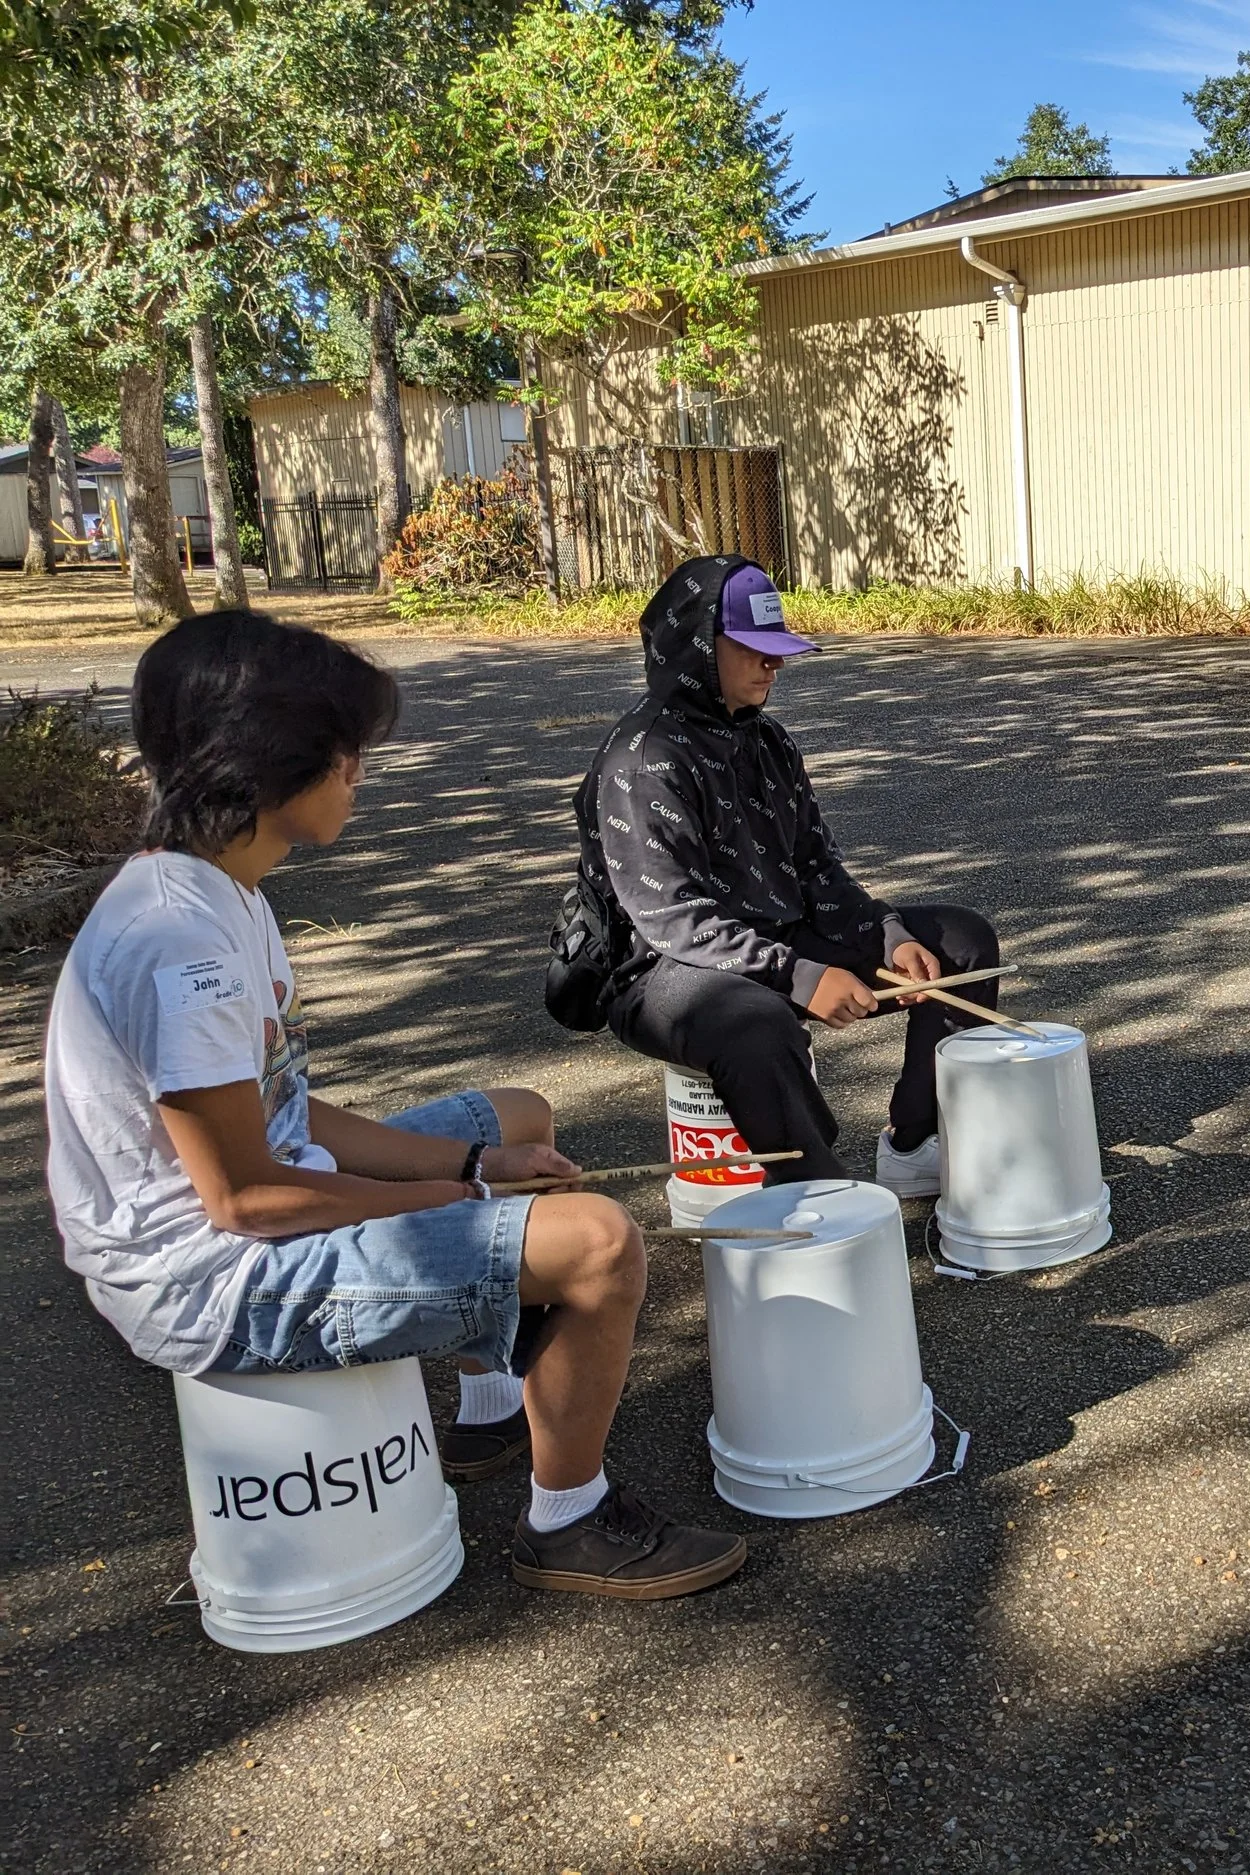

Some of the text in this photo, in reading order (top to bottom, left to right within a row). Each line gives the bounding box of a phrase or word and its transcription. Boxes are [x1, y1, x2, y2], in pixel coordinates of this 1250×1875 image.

[692, 636, 713, 655] KLEIN
[678, 673, 701, 691] KLEIN
[628, 730, 647, 751] KLEIN
[646, 761, 676, 773] CALVIN
[699, 754, 726, 772] CALVIN
[614, 775, 633, 793] KLEIN
[650, 801, 683, 824] CALVIN
[607, 815, 631, 834] KLEIN
[640, 874, 664, 892] KLEIN
[693, 929, 717, 944] KLEIN
[717, 956, 742, 971] KLEIN
[689, 1092, 716, 1100] ALLARD
[211, 1422, 430, 1521] valspar
